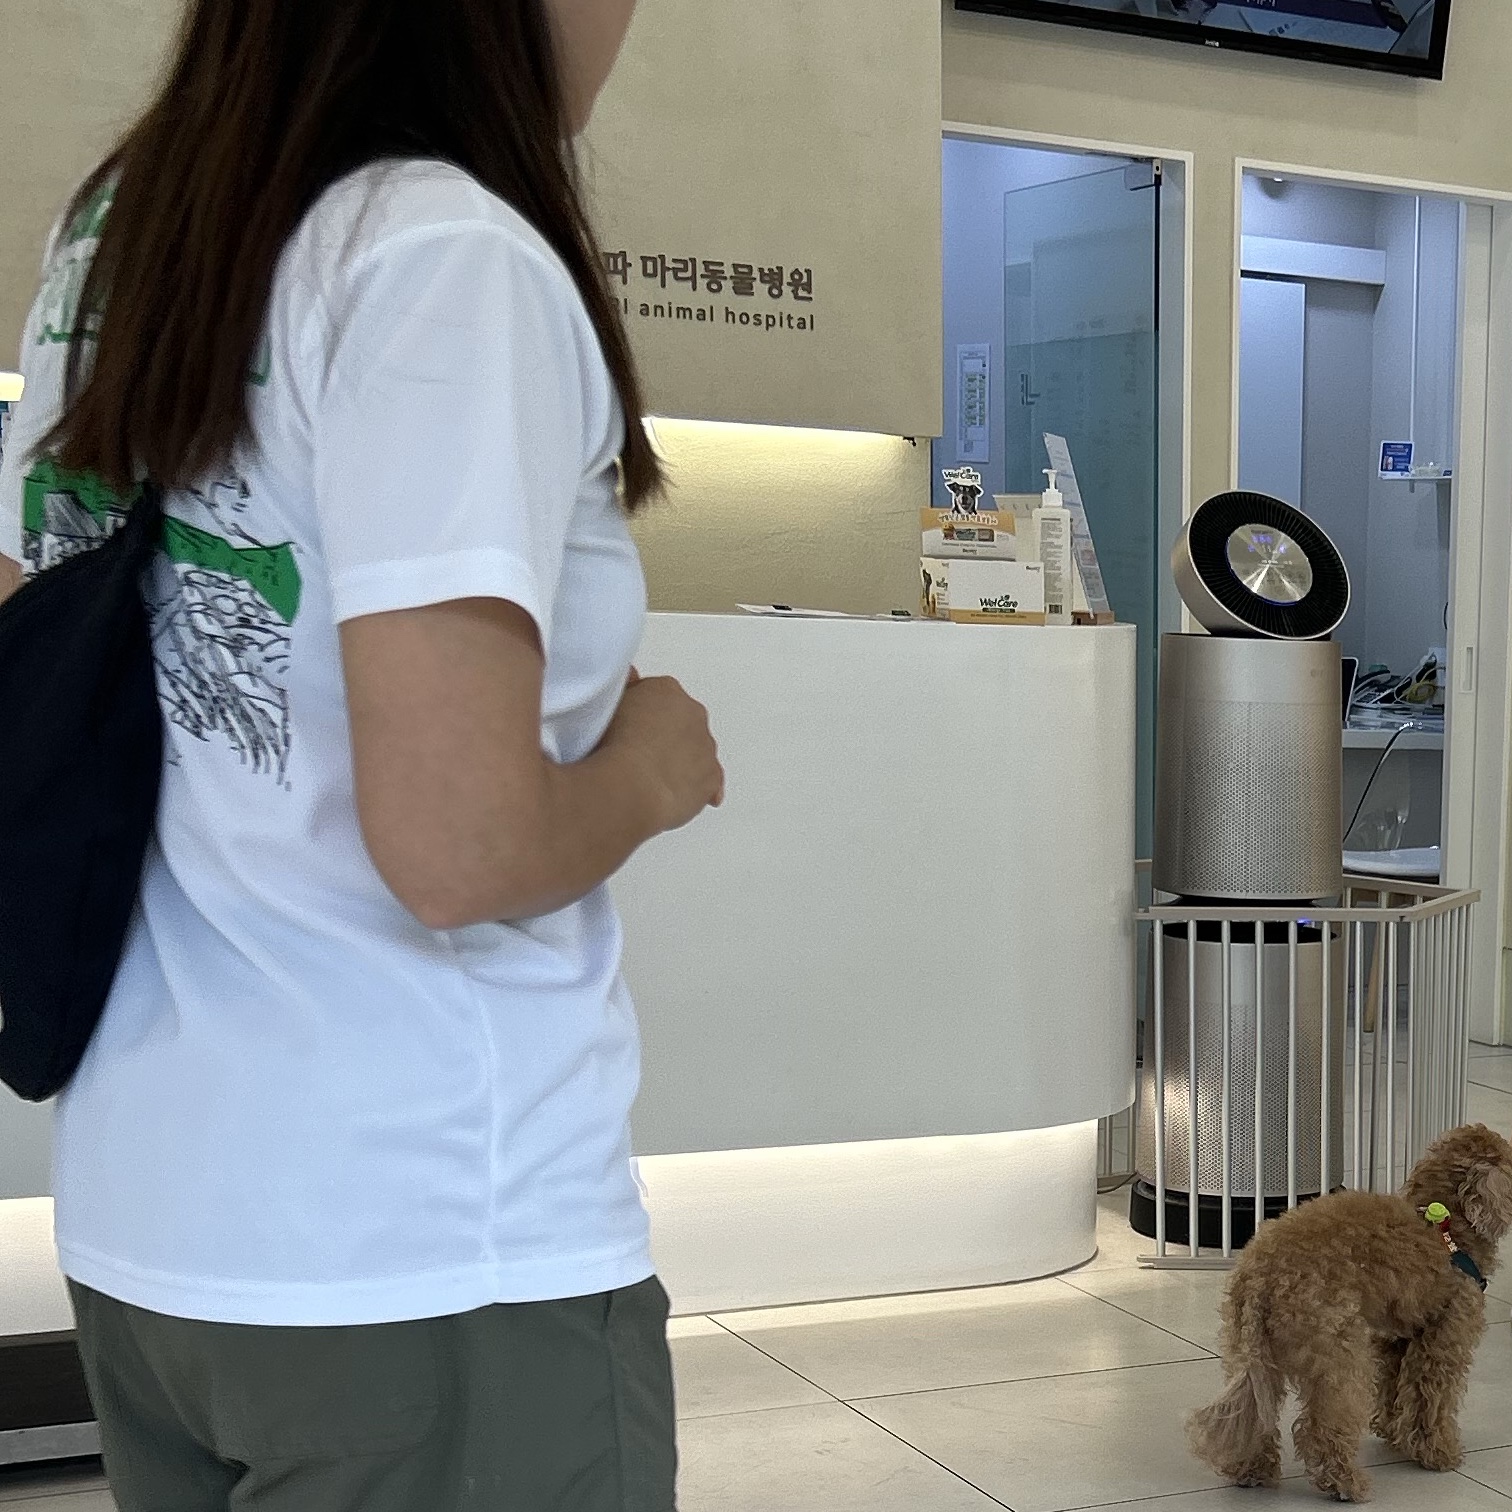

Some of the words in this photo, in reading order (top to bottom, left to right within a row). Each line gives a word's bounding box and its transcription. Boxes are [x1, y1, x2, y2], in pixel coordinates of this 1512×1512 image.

[640, 254, 813, 302] 마리동물병원
[639, 301, 714, 323] animal
[724, 306, 815, 332] hospital
